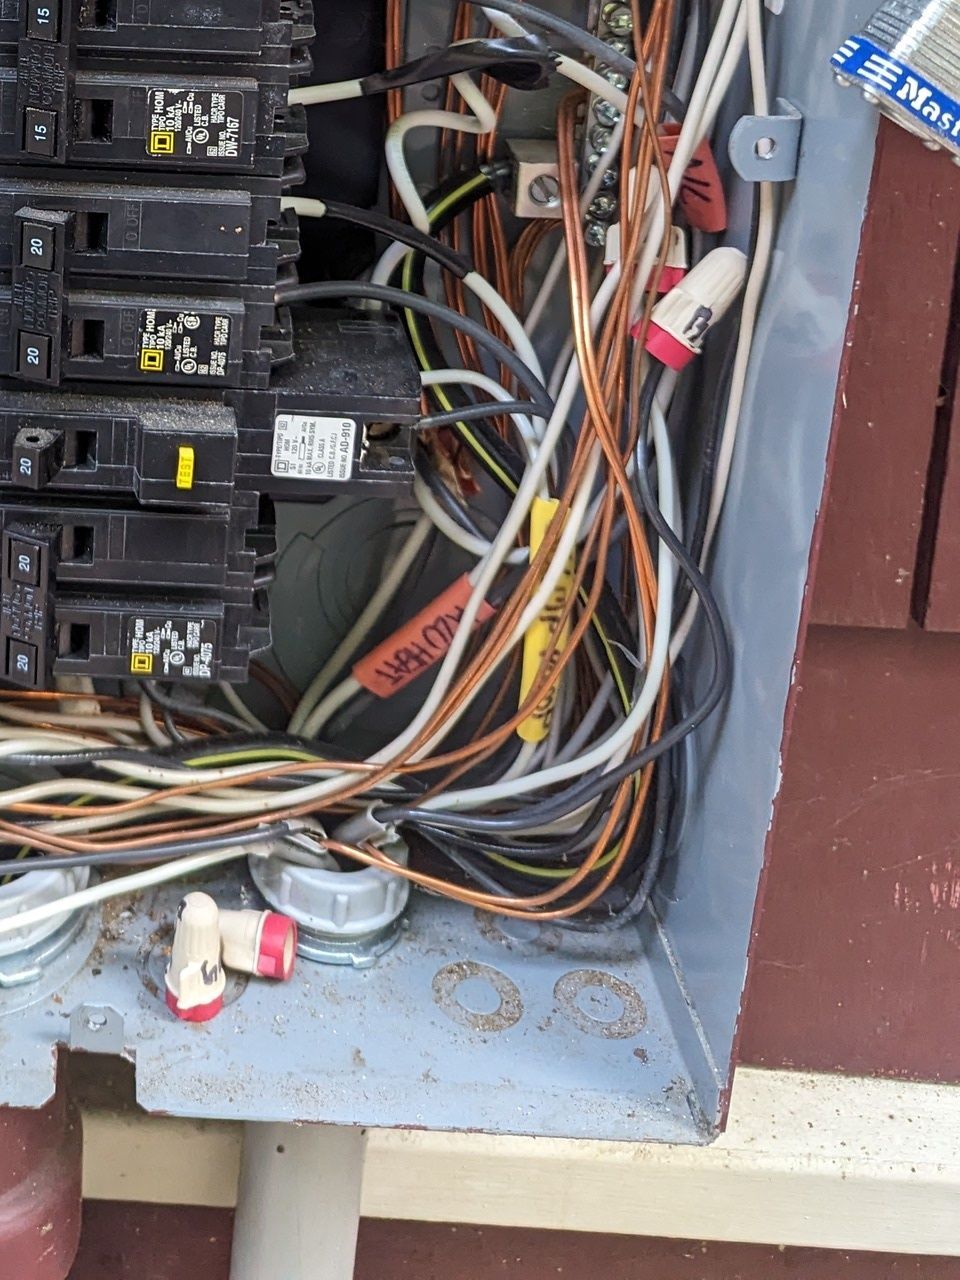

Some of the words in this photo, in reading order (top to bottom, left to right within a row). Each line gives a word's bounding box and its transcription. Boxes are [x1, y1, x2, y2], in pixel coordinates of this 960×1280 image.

[37, 8, 50, 25] 15
[155, 92, 164, 113] HOM
[35, 124, 47, 141] 15
[225, 117, 239, 156] DW-7167
[31, 238, 43, 256] 20
[145, 311, 155, 332] HOM
[27, 347, 39, 365] 20
[340, 422, 351, 453] AD-910
[20, 457, 32, 476] 20
[19, 554, 30, 572] 20
[17, 654, 28, 672] 20
